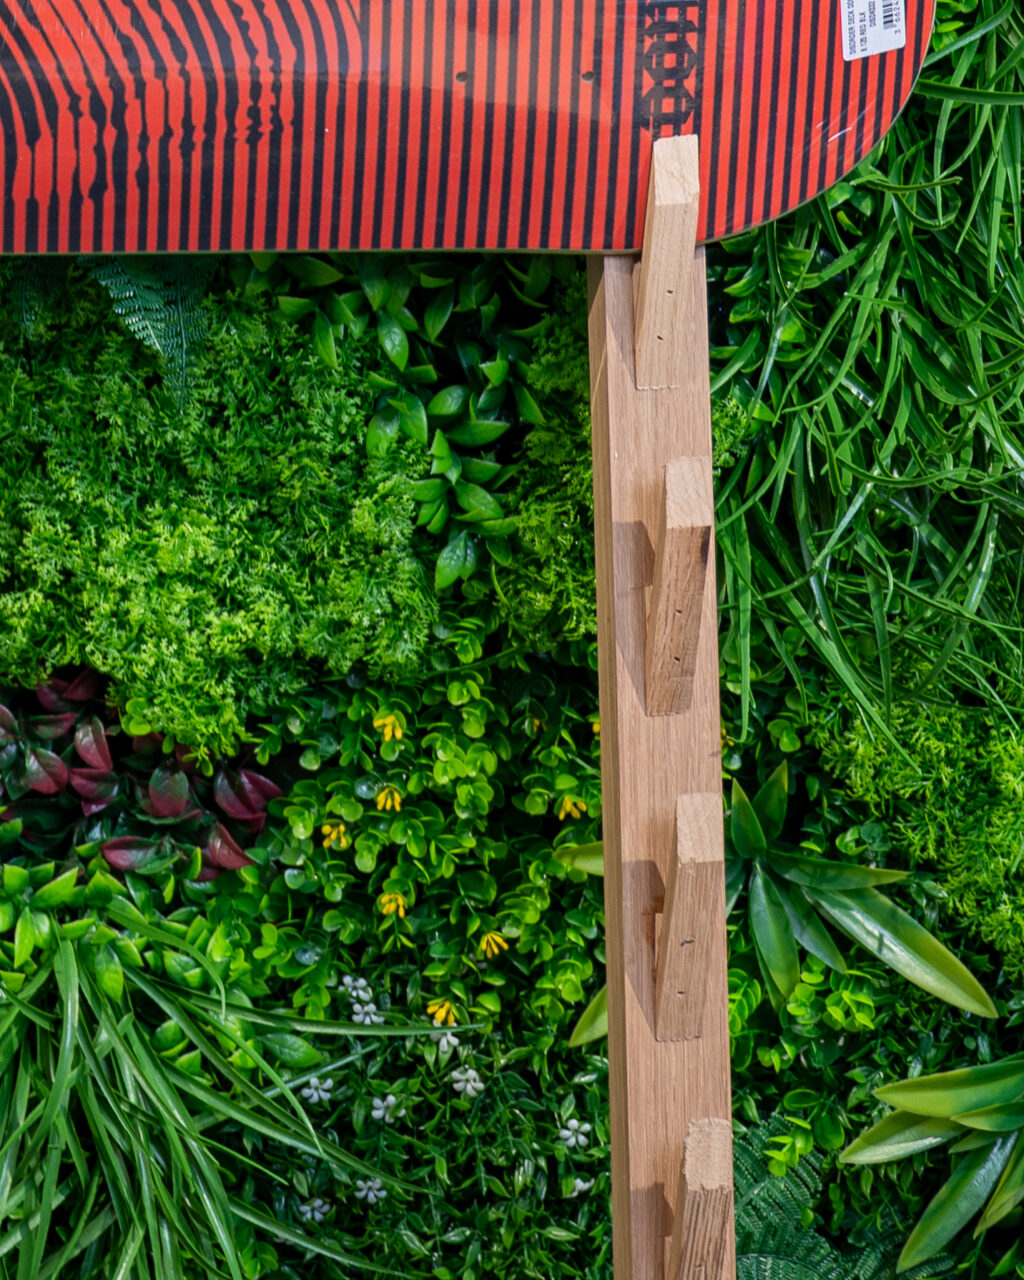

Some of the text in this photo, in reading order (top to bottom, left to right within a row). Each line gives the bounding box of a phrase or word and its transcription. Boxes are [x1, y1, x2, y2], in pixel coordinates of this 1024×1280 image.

[847, 10, 855, 25] DECK
[858, 11, 866, 23] BLK
[859, 24, 867, 36] RED
[848, 27, 856, 55] DISORDER
